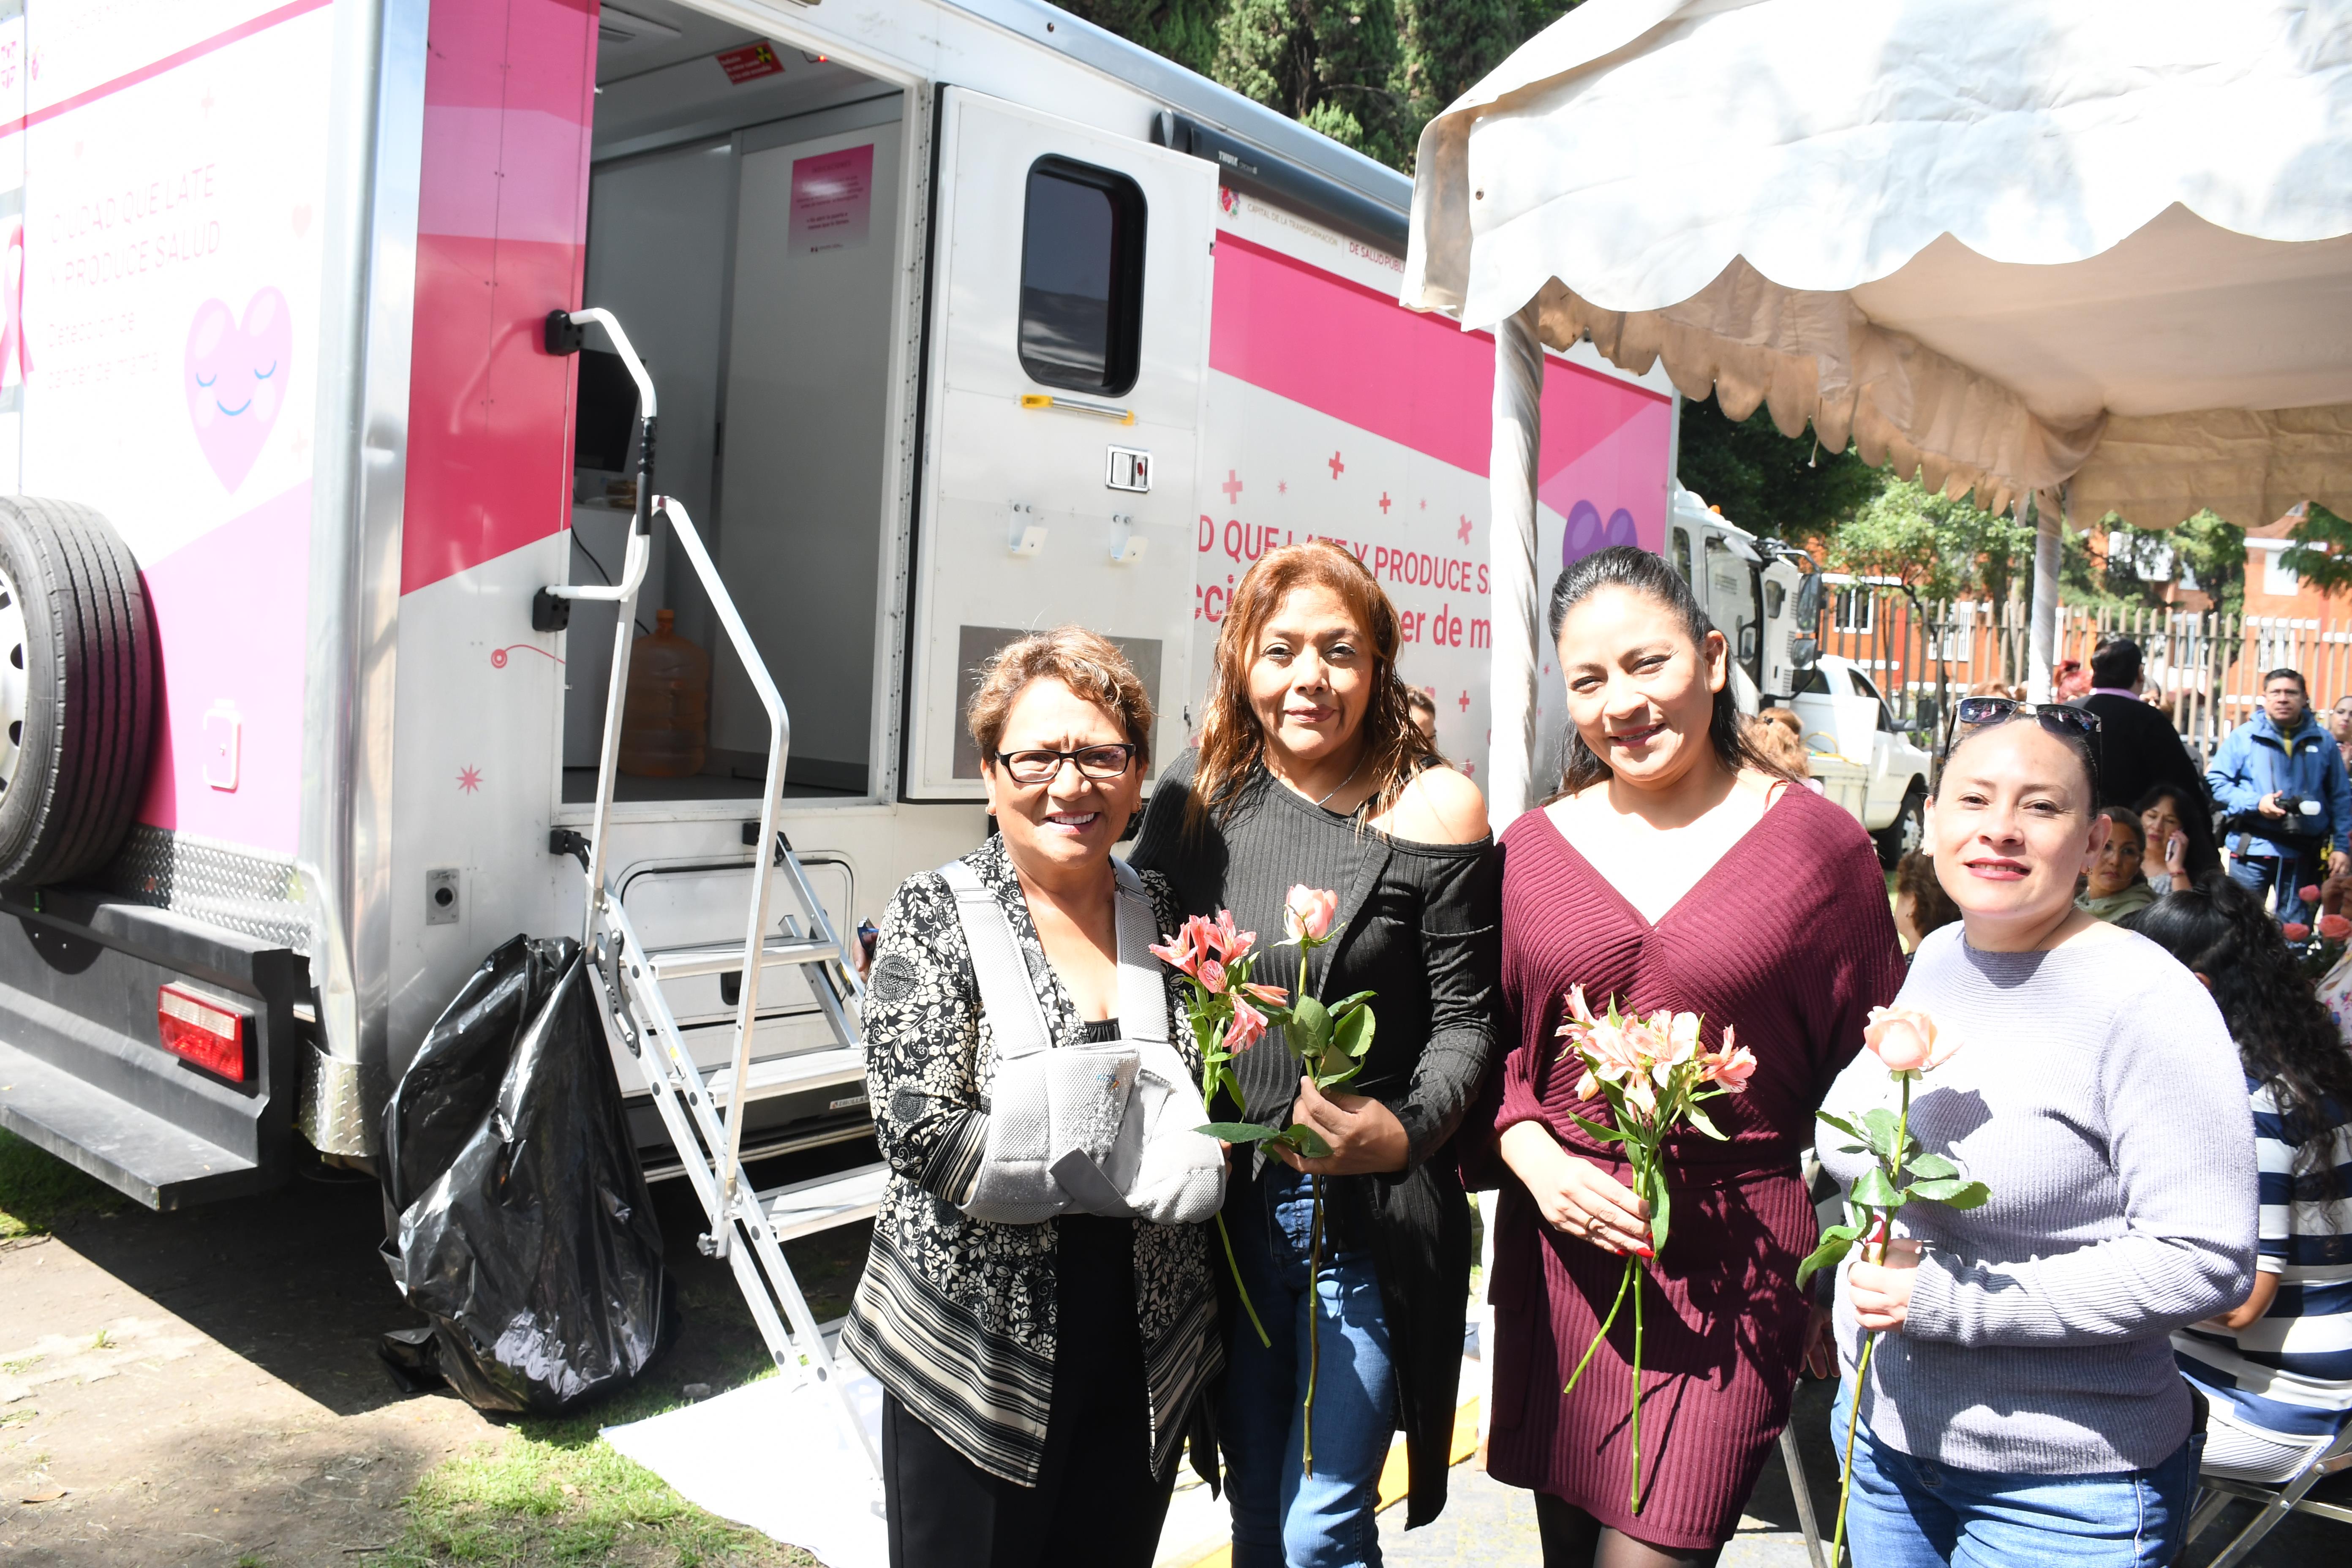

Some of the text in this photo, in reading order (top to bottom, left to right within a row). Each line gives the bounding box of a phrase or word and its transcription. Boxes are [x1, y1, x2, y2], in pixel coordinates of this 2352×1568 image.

[1218, 150, 1238, 167] THULE
[51, 163, 215, 244] CIUDAD QUE LATE
[1247, 203, 1270, 219] CAPITAL
[1271, 212, 1279, 223] DE
[1280, 217, 1287, 225] LA
[65, 240, 149, 291] PRODUCE
[155, 220, 220, 268] SALUD
[1350, 242, 1359, 255] DE
[1361, 246, 1384, 265] SALUD
[1224, 520, 1279, 564] QUE
[1374, 546, 1472, 593] PRODUCE
[1477, 564, 1492, 595] S
[1433, 603, 1462, 648] de
